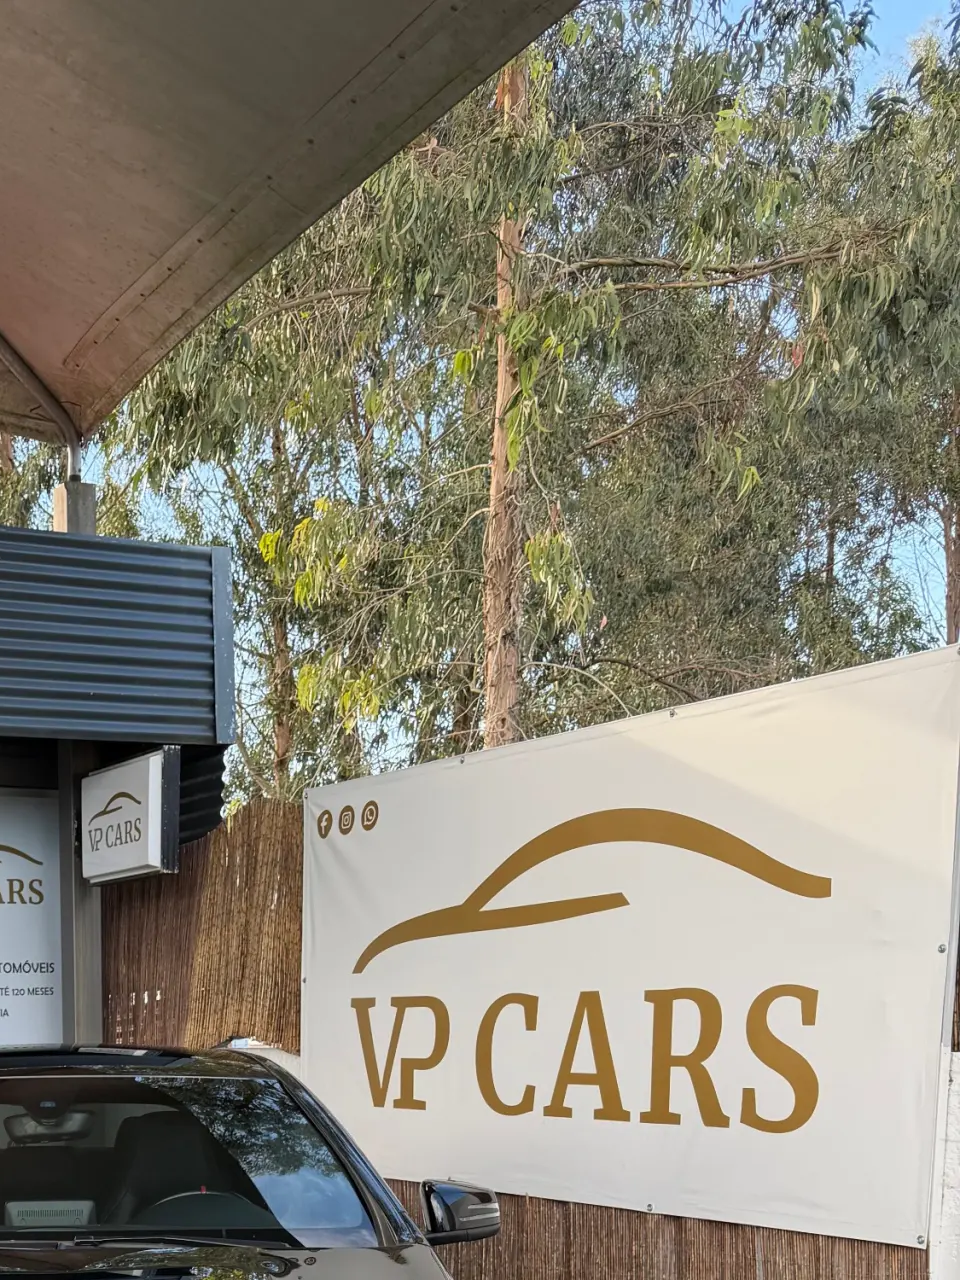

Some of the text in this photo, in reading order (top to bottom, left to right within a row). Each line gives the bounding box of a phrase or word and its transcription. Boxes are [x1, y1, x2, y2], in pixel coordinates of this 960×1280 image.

[88, 818, 142, 853] VP CARS
[11, 988, 26, 997] 120
[27, 986, 55, 996] MESES
[350, 983, 820, 1134] VP CARS
